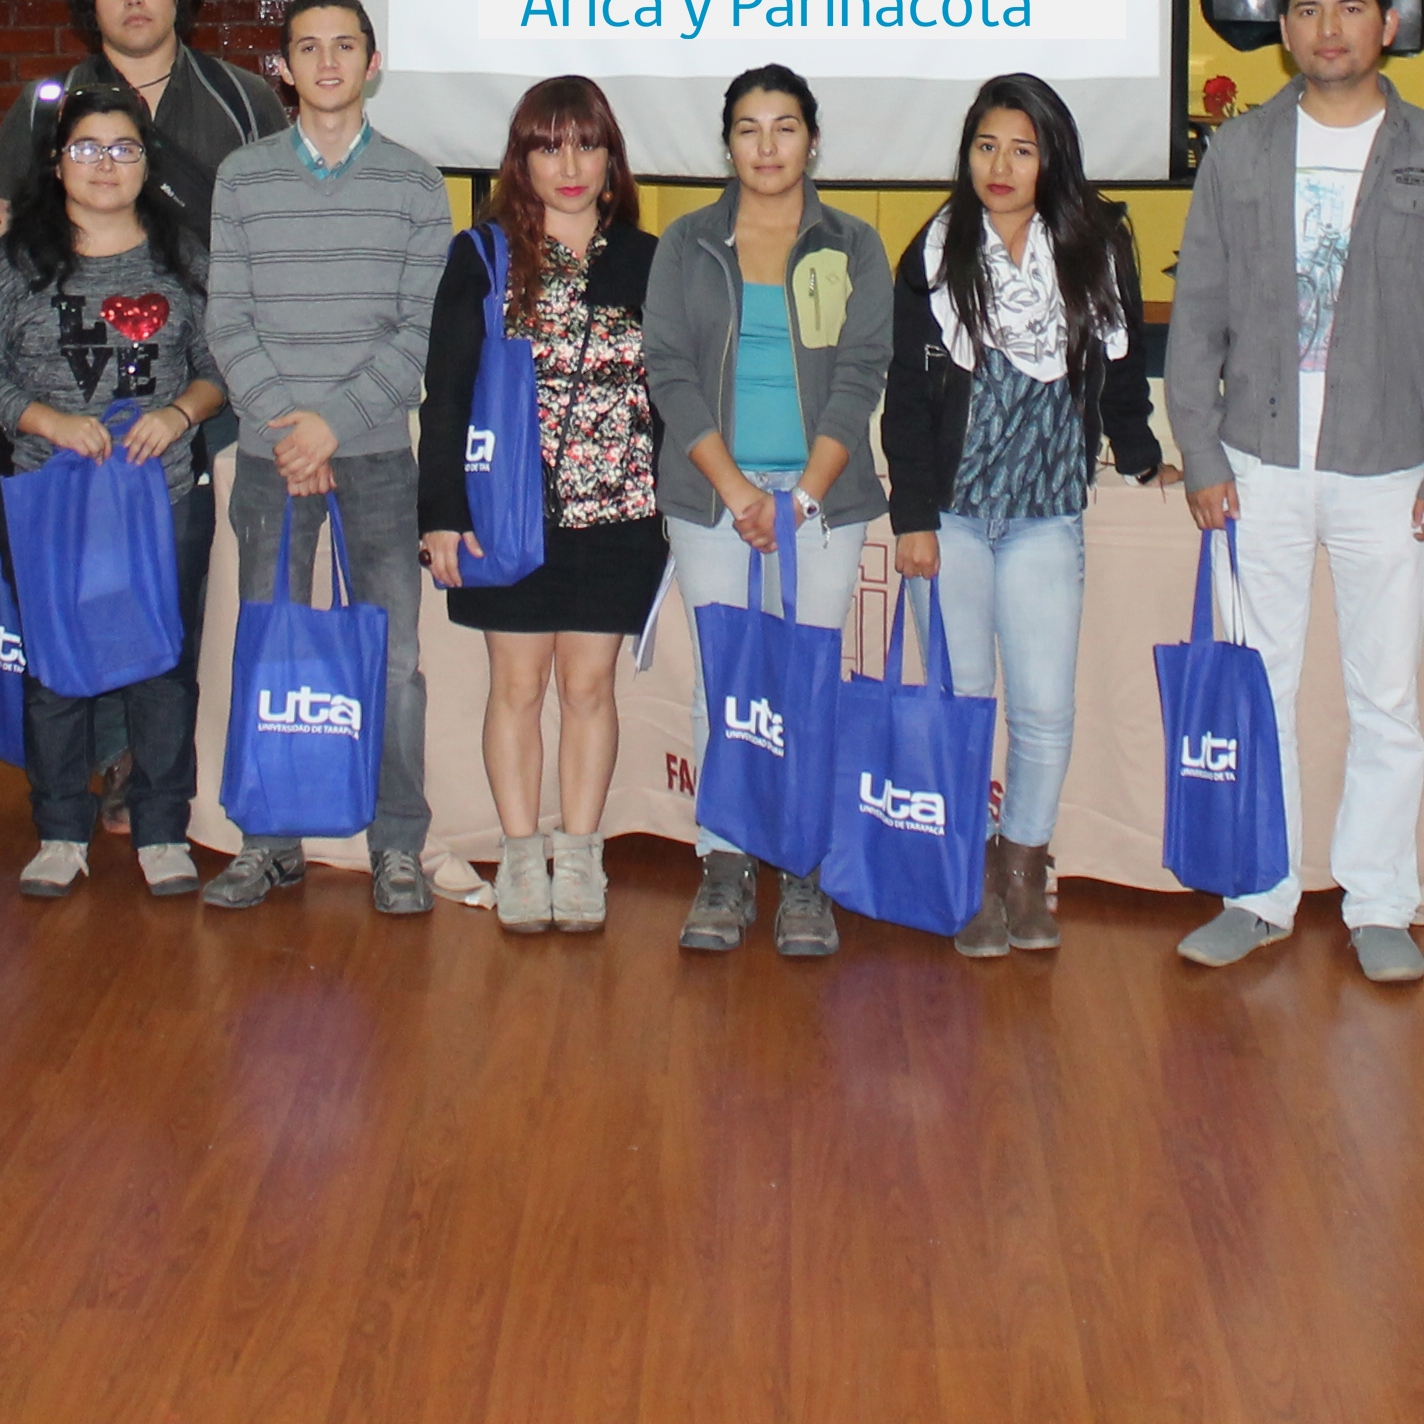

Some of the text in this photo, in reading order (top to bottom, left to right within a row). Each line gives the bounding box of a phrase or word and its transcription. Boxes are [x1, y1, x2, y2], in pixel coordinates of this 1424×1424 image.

[257, 722, 311, 734] UNIVERSIDAD
[311, 724, 323, 734] DE
[258, 686, 363, 732] uta
[859, 771, 946, 827] uta
